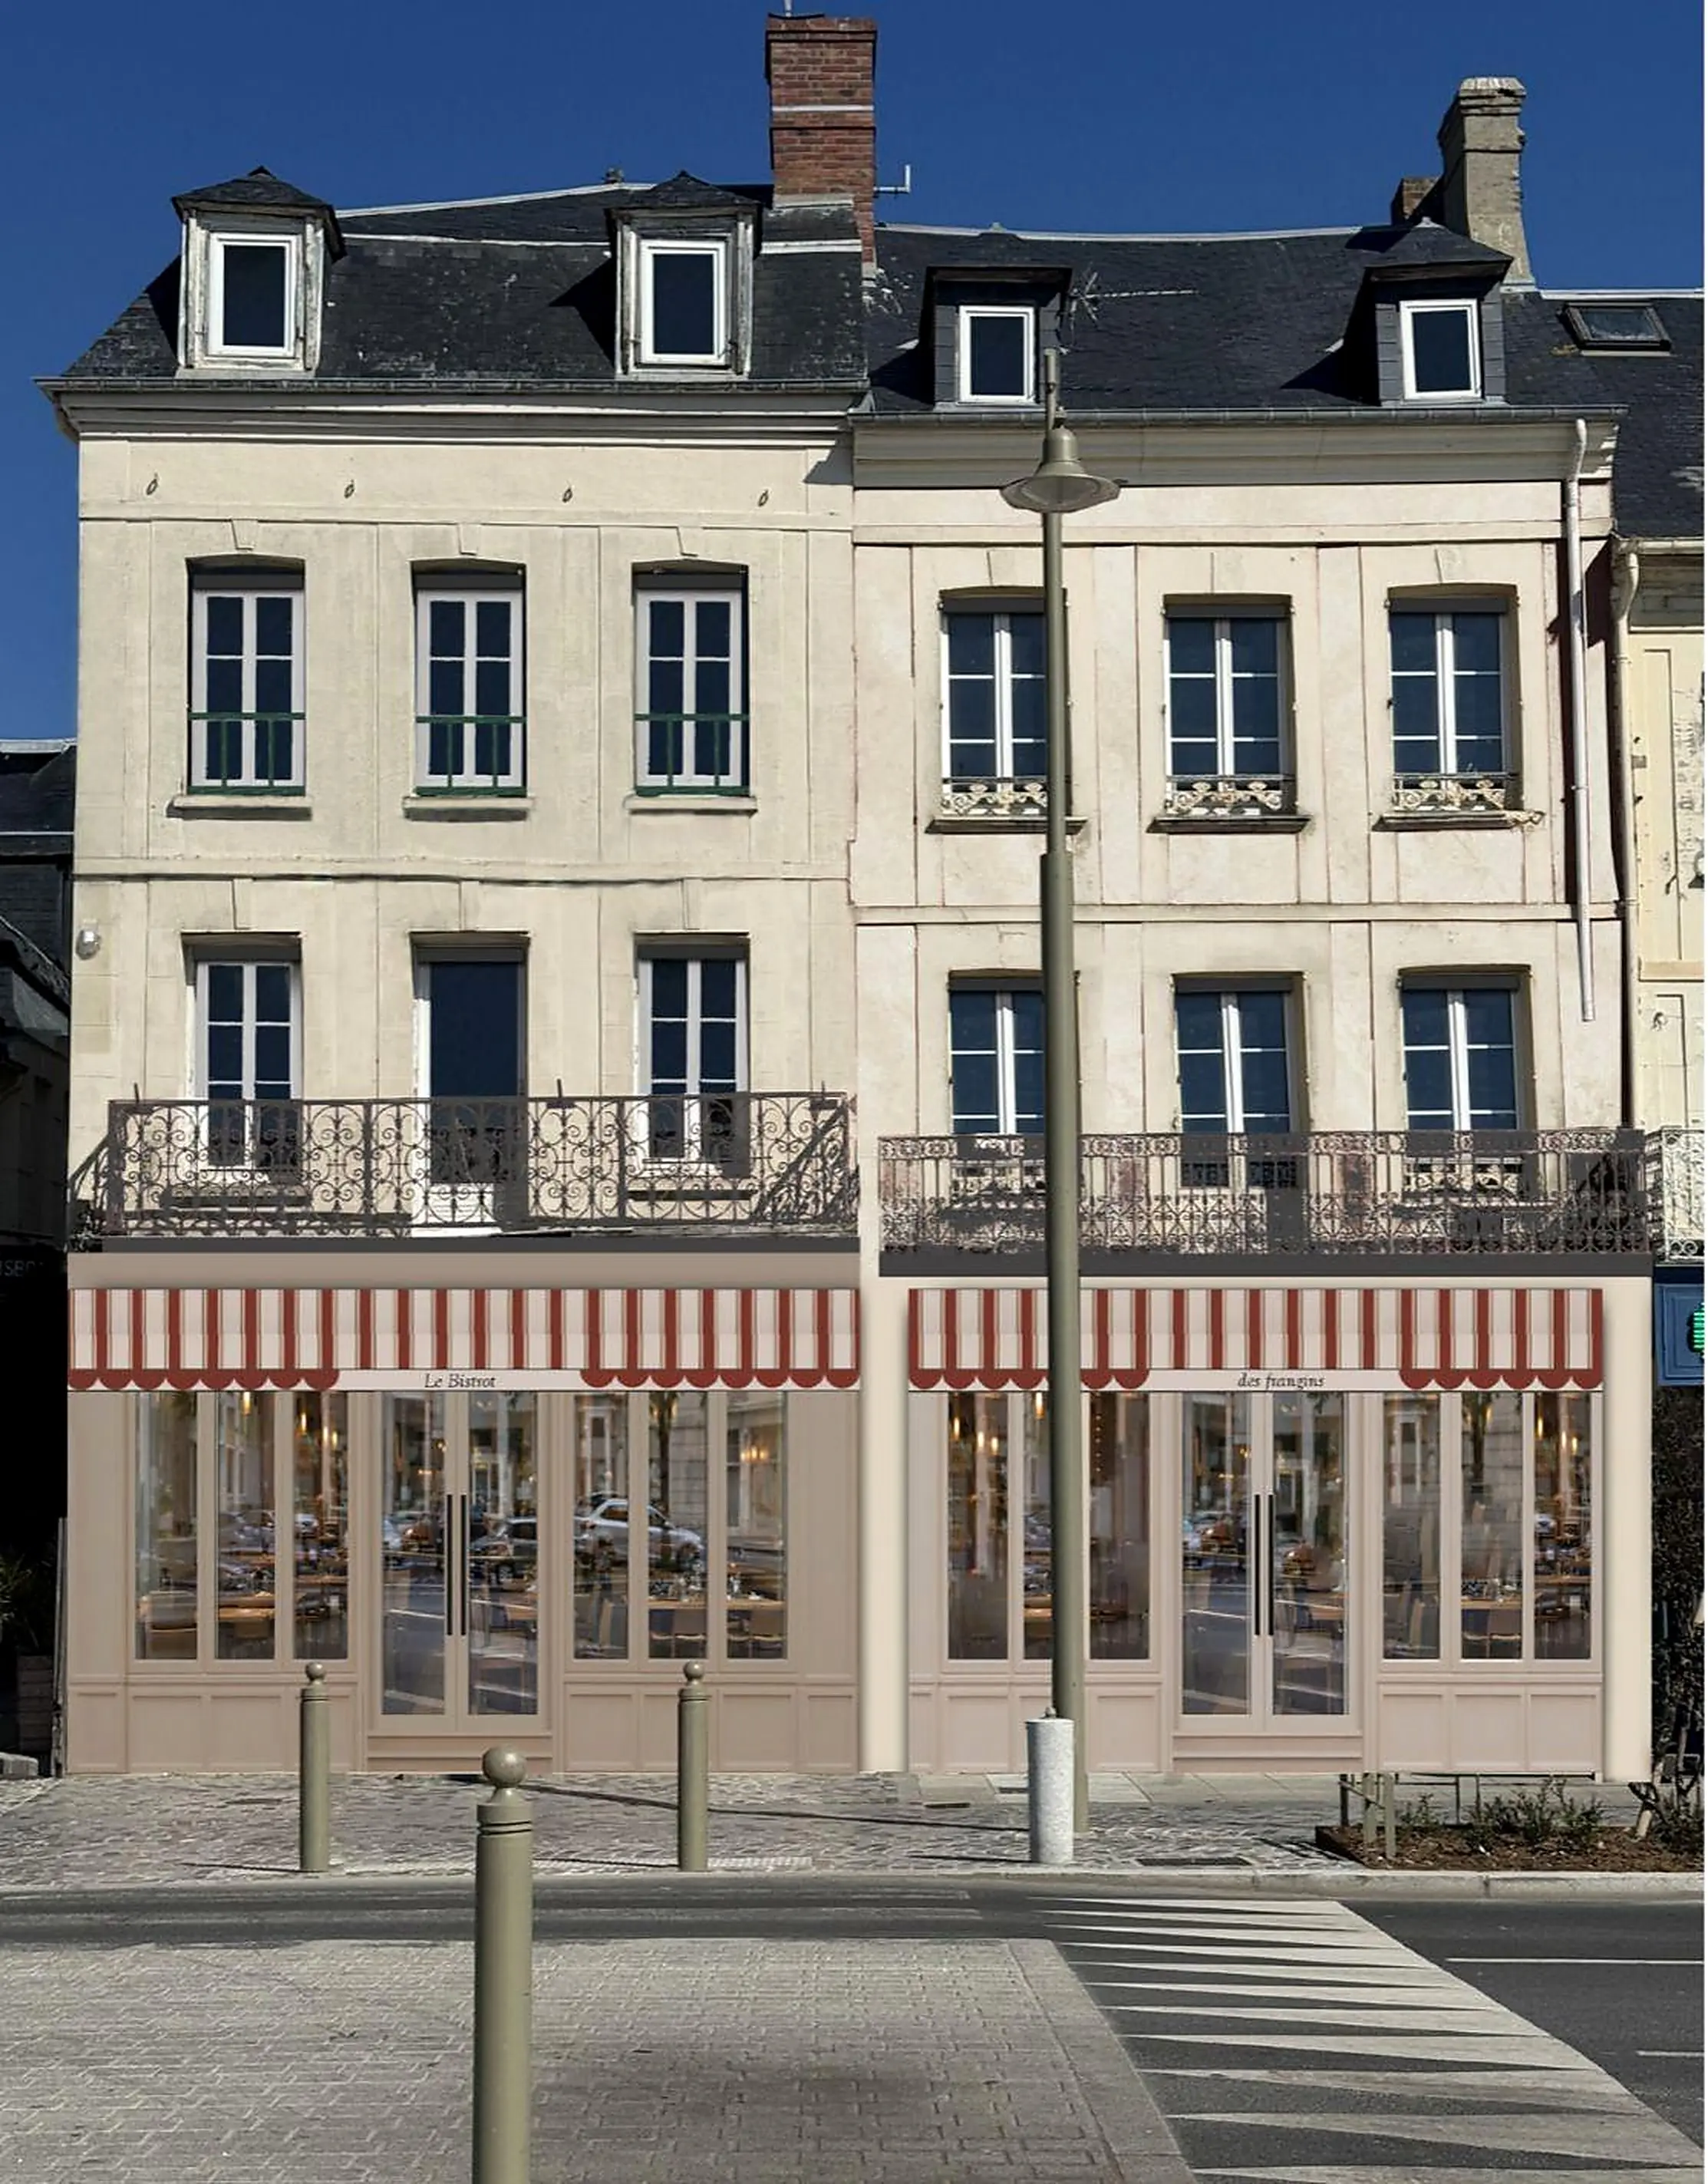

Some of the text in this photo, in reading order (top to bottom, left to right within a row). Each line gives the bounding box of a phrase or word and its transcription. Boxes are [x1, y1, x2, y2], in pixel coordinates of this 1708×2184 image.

[424, 1373, 496, 1387] Le Bistrot
[1238, 1372, 1325, 1390] des frangins
